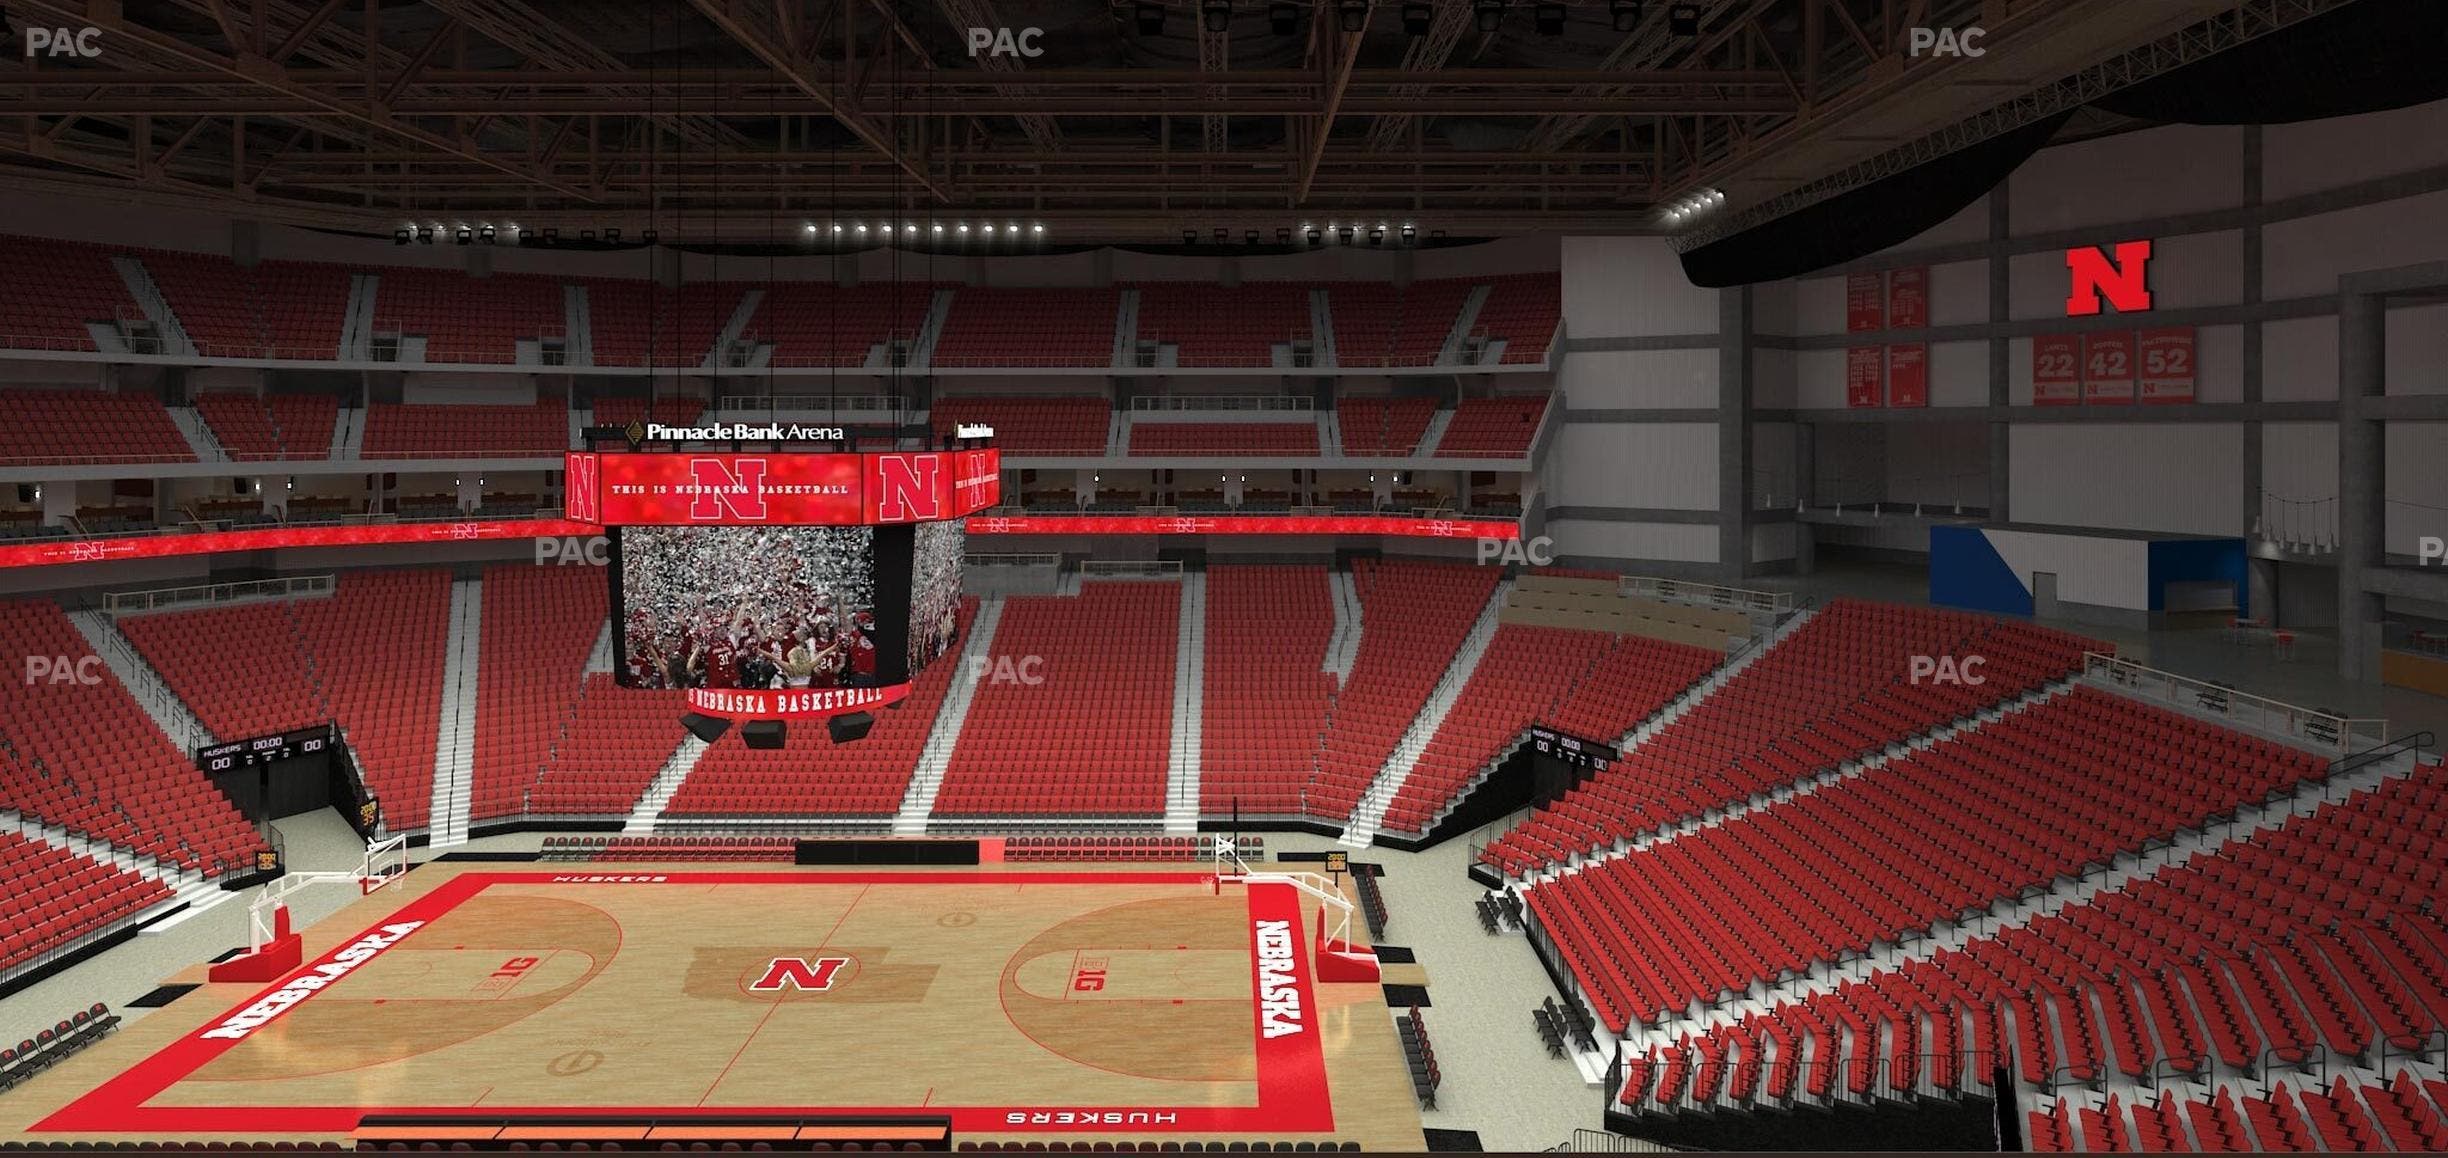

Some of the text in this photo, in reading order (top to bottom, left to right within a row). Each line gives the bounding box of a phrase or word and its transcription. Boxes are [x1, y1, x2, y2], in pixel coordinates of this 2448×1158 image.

[2066, 239, 2151, 316] N
[2037, 353, 2075, 378] 22
[2088, 351, 2127, 376] 42
[2146, 348, 2188, 375] 52
[647, 422, 844, 440] Pinnacle Bank Arena
[570, 454, 595, 521] N
[612, 485, 848, 494] THIS IS NEBRASKA BASKETBALL
[691, 458, 767, 520] N
[879, 454, 939, 521] N
[718, 654, 730, 666] 31
[820, 657, 833, 670] 24
[697, 687, 766, 714] NEBRASKA
[777, 687, 883, 713] BASKETBALL
[203, 744, 241, 758] HUSKERS
[253, 736, 283, 751] 00:00
[304, 739, 322, 752] 00
[1536, 740, 1549, 753] 00
[211, 757, 231, 771] 00
[552, 875, 668, 883] HUSKERS
[199, 920, 426, 1040] NEBRASKA
[748, 957, 851, 991] N
[1255, 919, 1304, 1039] NEBRASKA
[1005, 1111, 1177, 1125] HUSKERS
